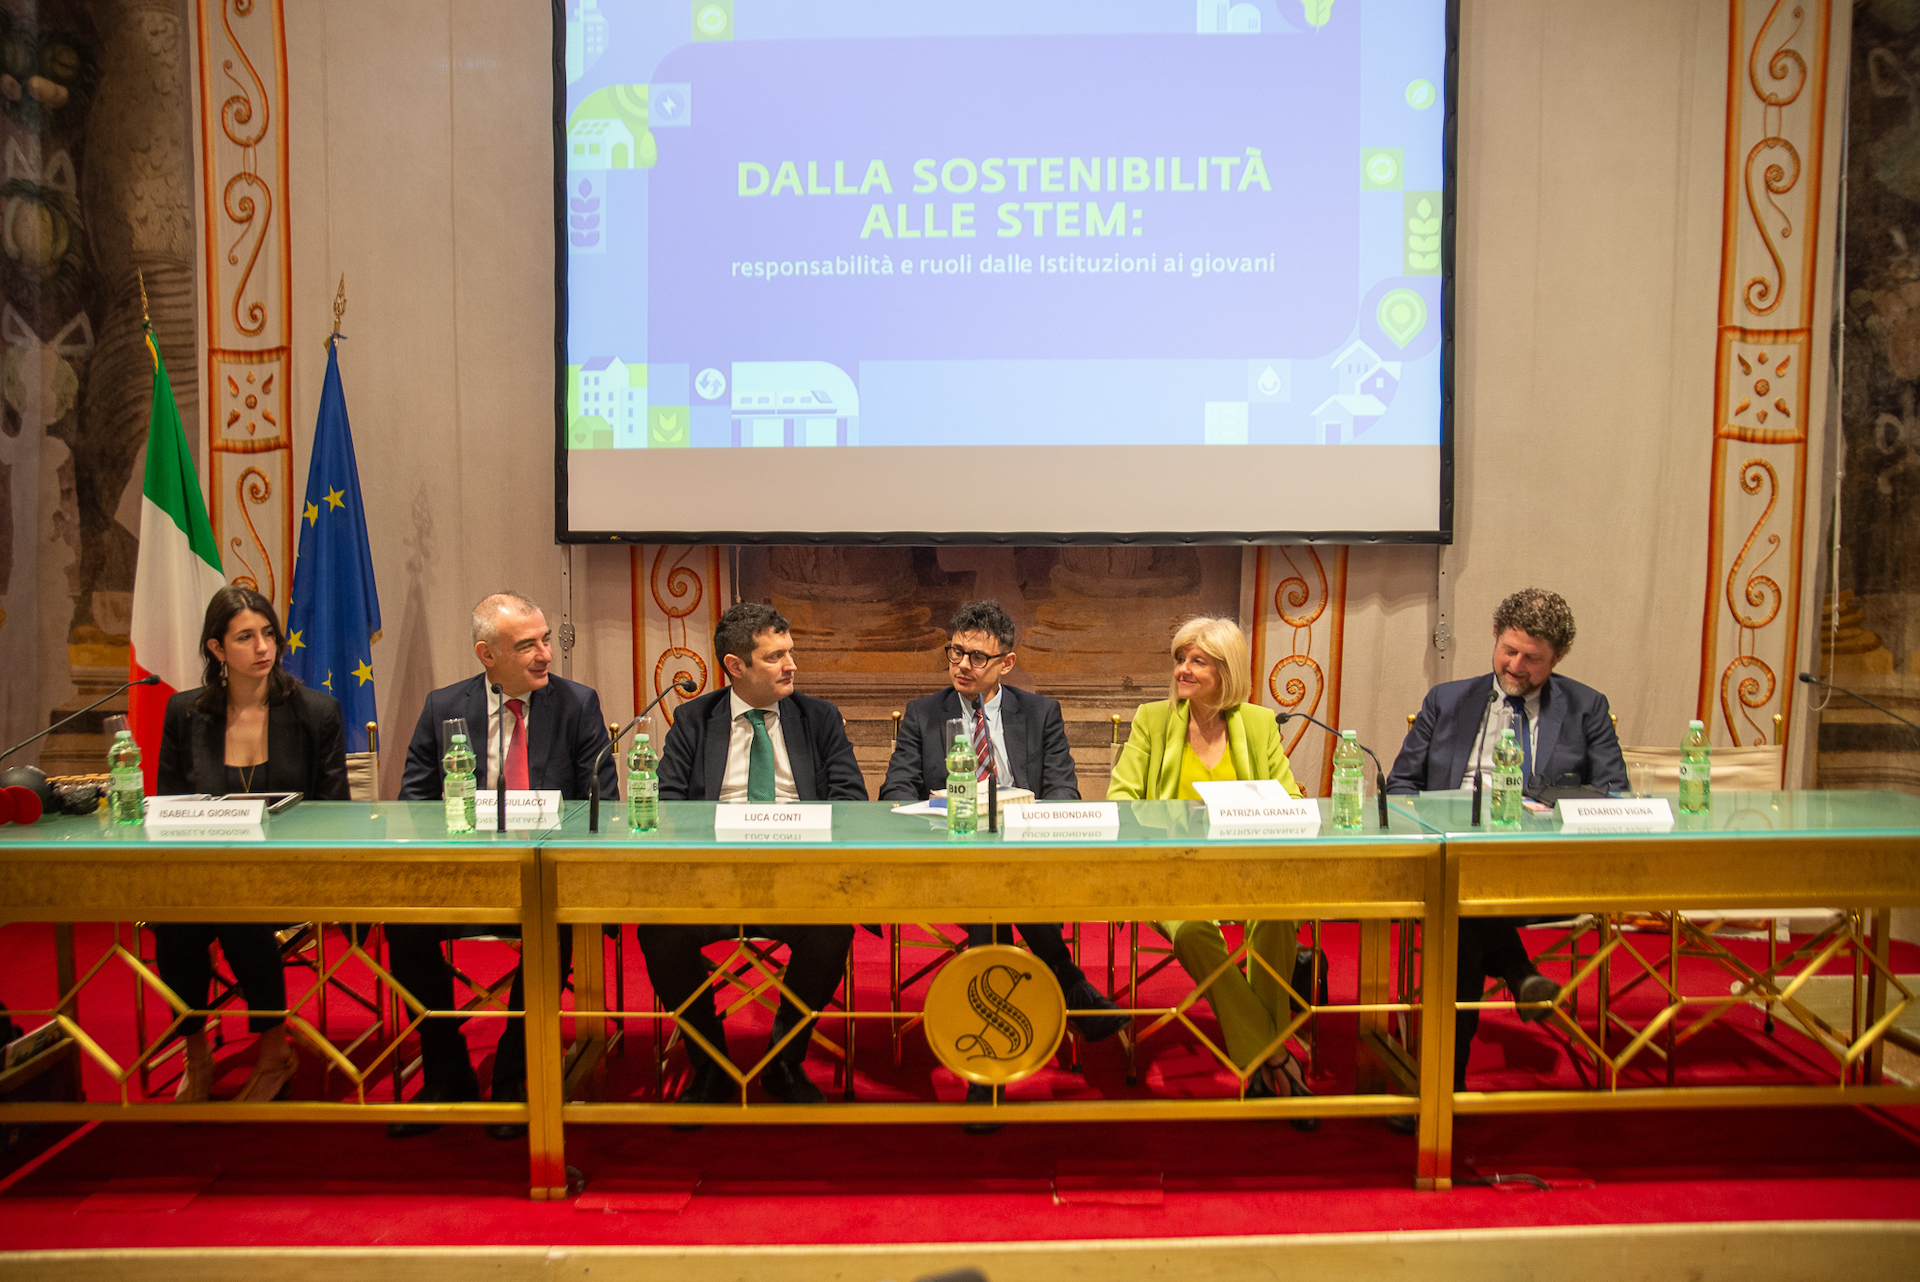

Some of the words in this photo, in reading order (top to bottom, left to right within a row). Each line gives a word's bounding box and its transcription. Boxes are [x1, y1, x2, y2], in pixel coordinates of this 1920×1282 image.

[737, 159, 893, 196] DALLA
[912, 146, 1273, 194] SOSTENIBILITÀ
[860, 202, 977, 239] ALLE
[996, 201, 1144, 237] STEM:
[731, 255, 894, 281] responsabilità
[901, 260, 914, 275] e
[920, 253, 972, 275] ruoli
[979, 253, 1033, 274] dalle
[1040, 252, 1157, 274] Istituzioni
[1163, 252, 1184, 274] ai
[1190, 252, 1276, 278] giovani
[1506, 776, 1522, 786] BIO
[948, 784, 966, 794] BIO
[504, 798, 547, 807] GIULIACCI
[159, 809, 205, 818] ISABELLA
[207, 808, 250, 817] GIORGINI
[1022, 811, 1050, 820] LUCIO
[1052, 810, 1102, 819] BIONDARO
[1220, 808, 1261, 817] PATRIZIA
[1263, 807, 1308, 816] GRANATA
[1577, 807, 1623, 816] EDOARDO
[1624, 807, 1654, 816] VIGNA
[744, 813, 770, 822] LUCA
[772, 813, 802, 822] CONTI
[955, 964, 1034, 1062] S
